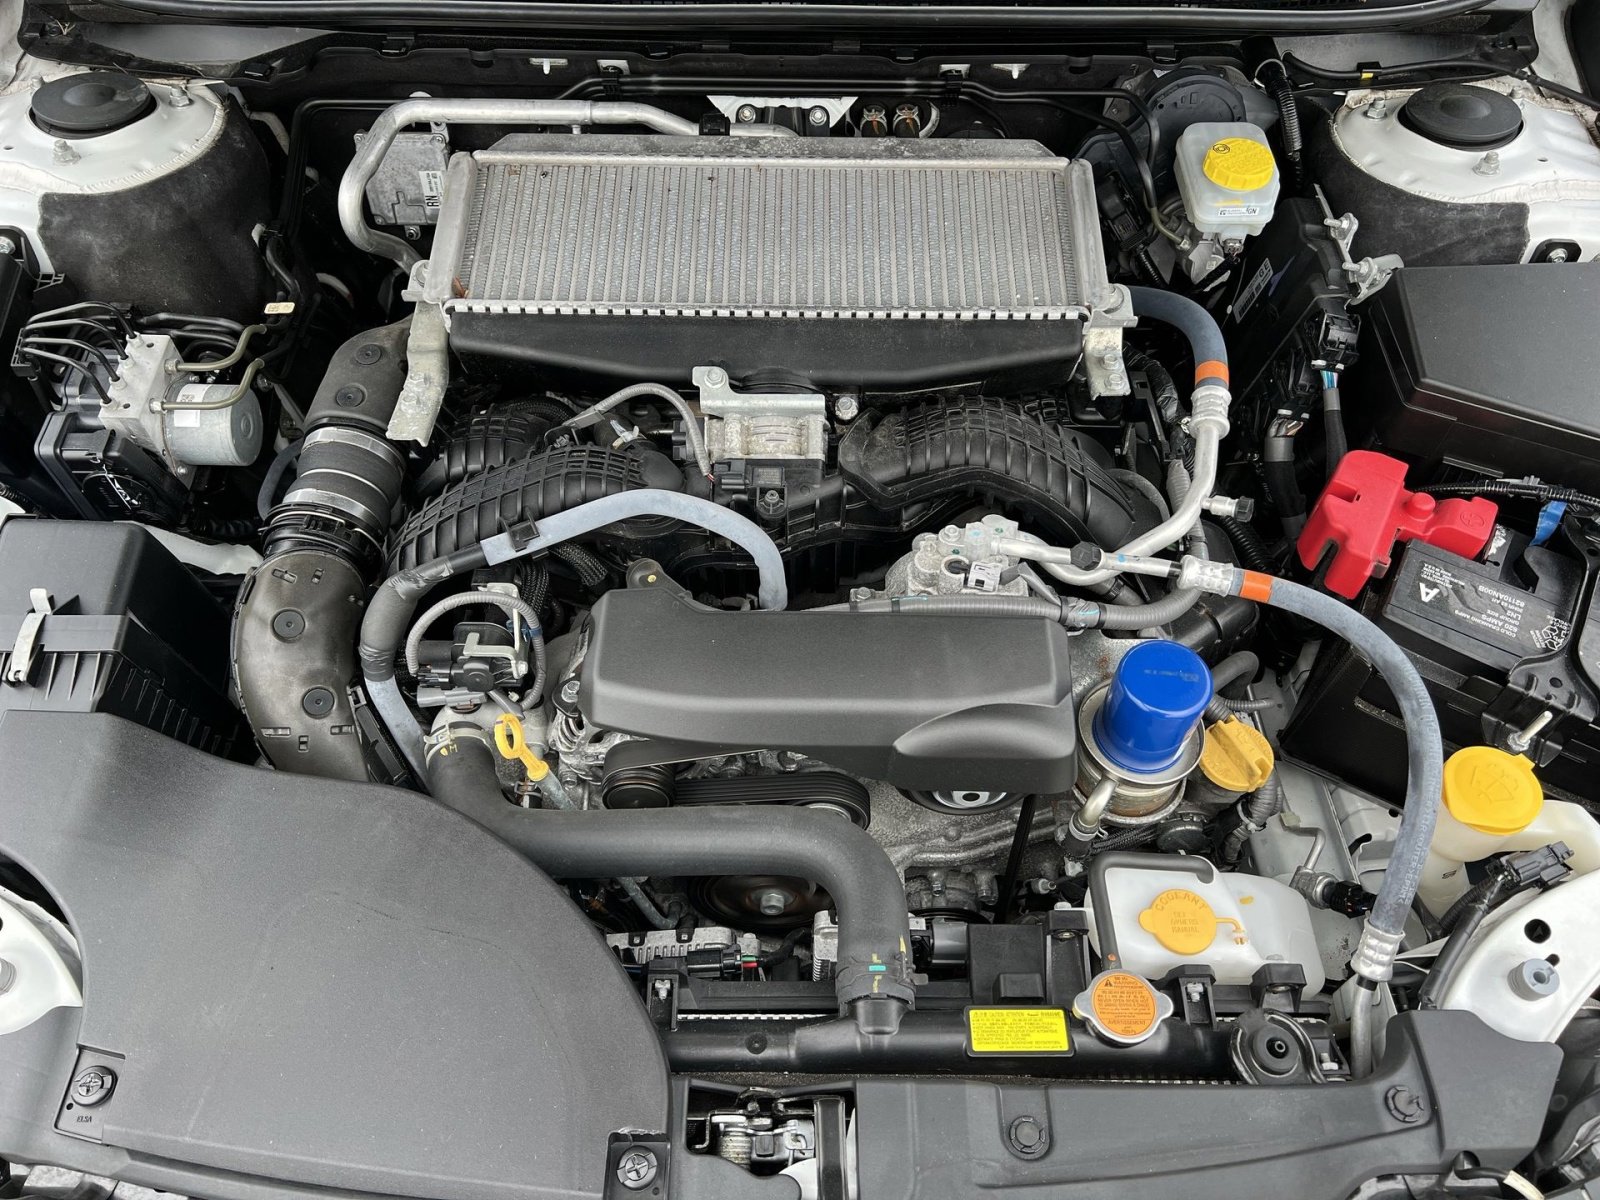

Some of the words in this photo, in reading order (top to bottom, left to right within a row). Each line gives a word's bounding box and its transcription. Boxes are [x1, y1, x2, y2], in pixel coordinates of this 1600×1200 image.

[425, 195, 440, 206] RN
[1420, 582, 1440, 602] A
[1482, 614, 1504, 626] AMPS
[1506, 610, 1521, 620] LN2
[1500, 628, 1516, 638] COLD
